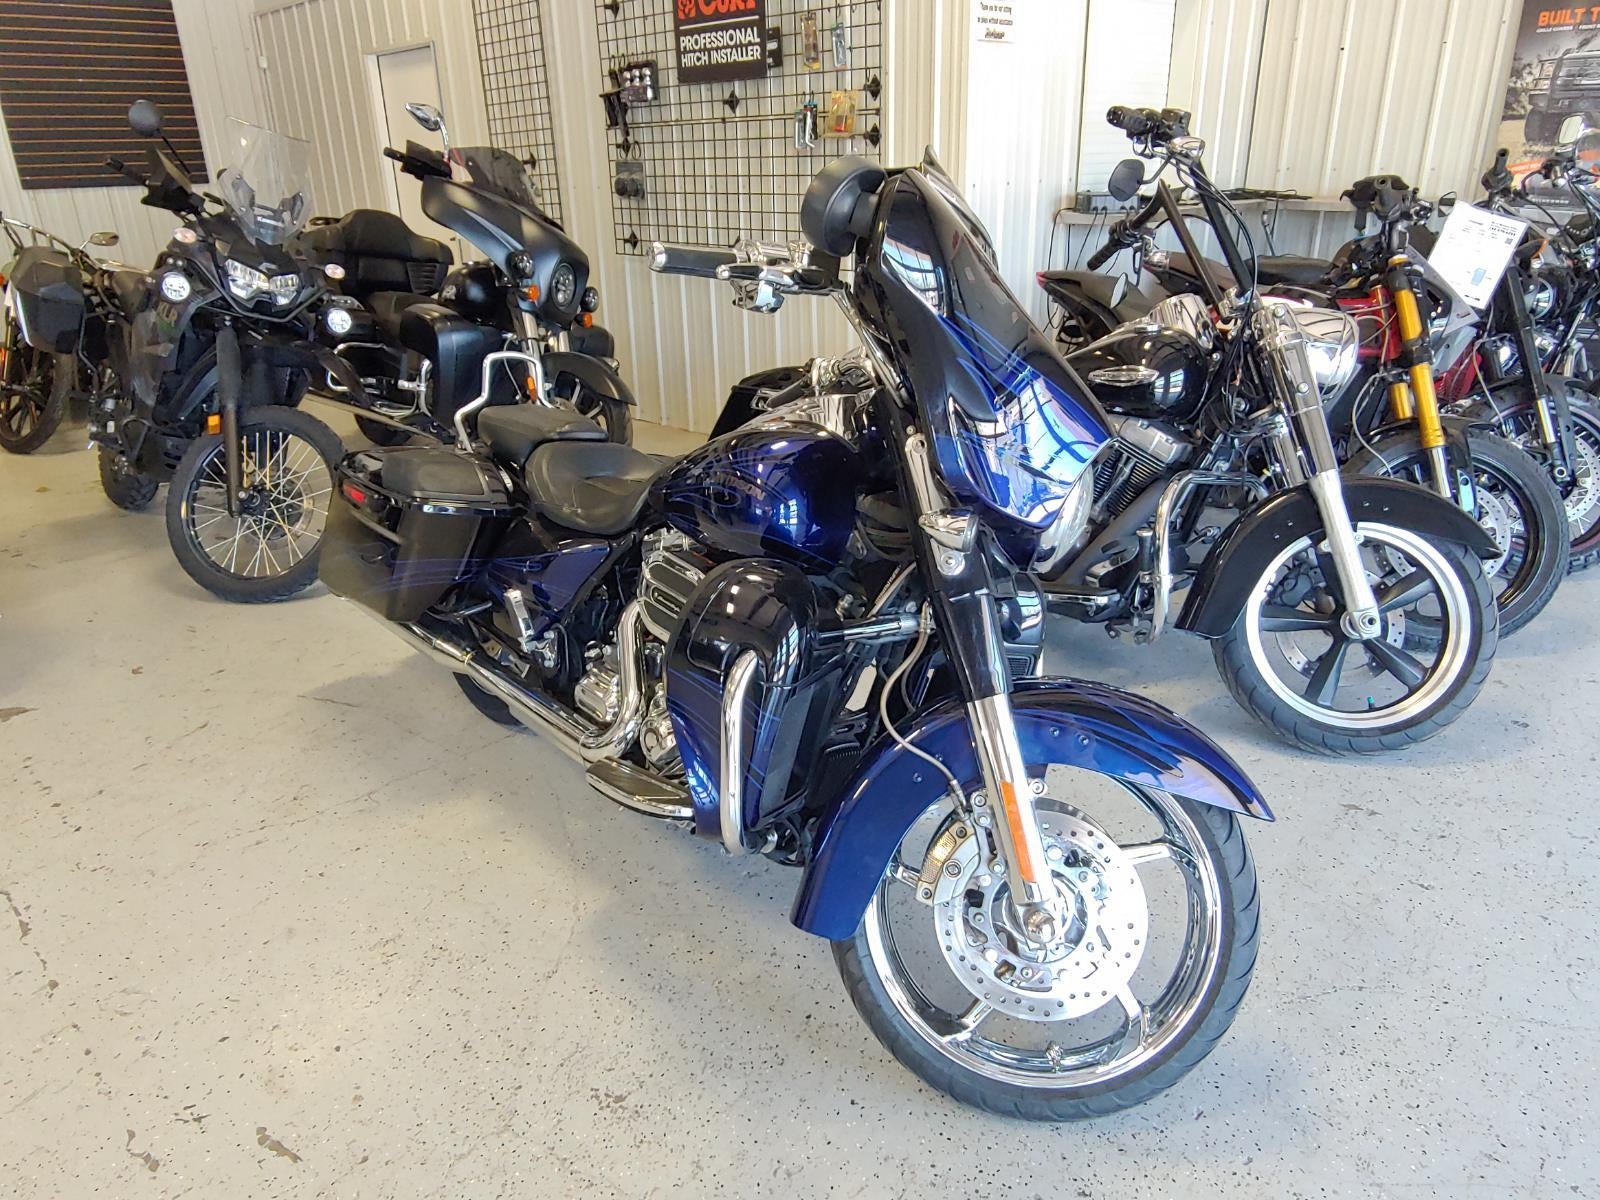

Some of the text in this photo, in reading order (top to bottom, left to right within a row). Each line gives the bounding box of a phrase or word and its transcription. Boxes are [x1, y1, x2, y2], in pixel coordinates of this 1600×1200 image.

[1537, 8, 1586, 27] BUILT
[680, 27, 760, 51] PROFESSIONAL
[681, 45, 760, 68] HITCH INSTALLER
